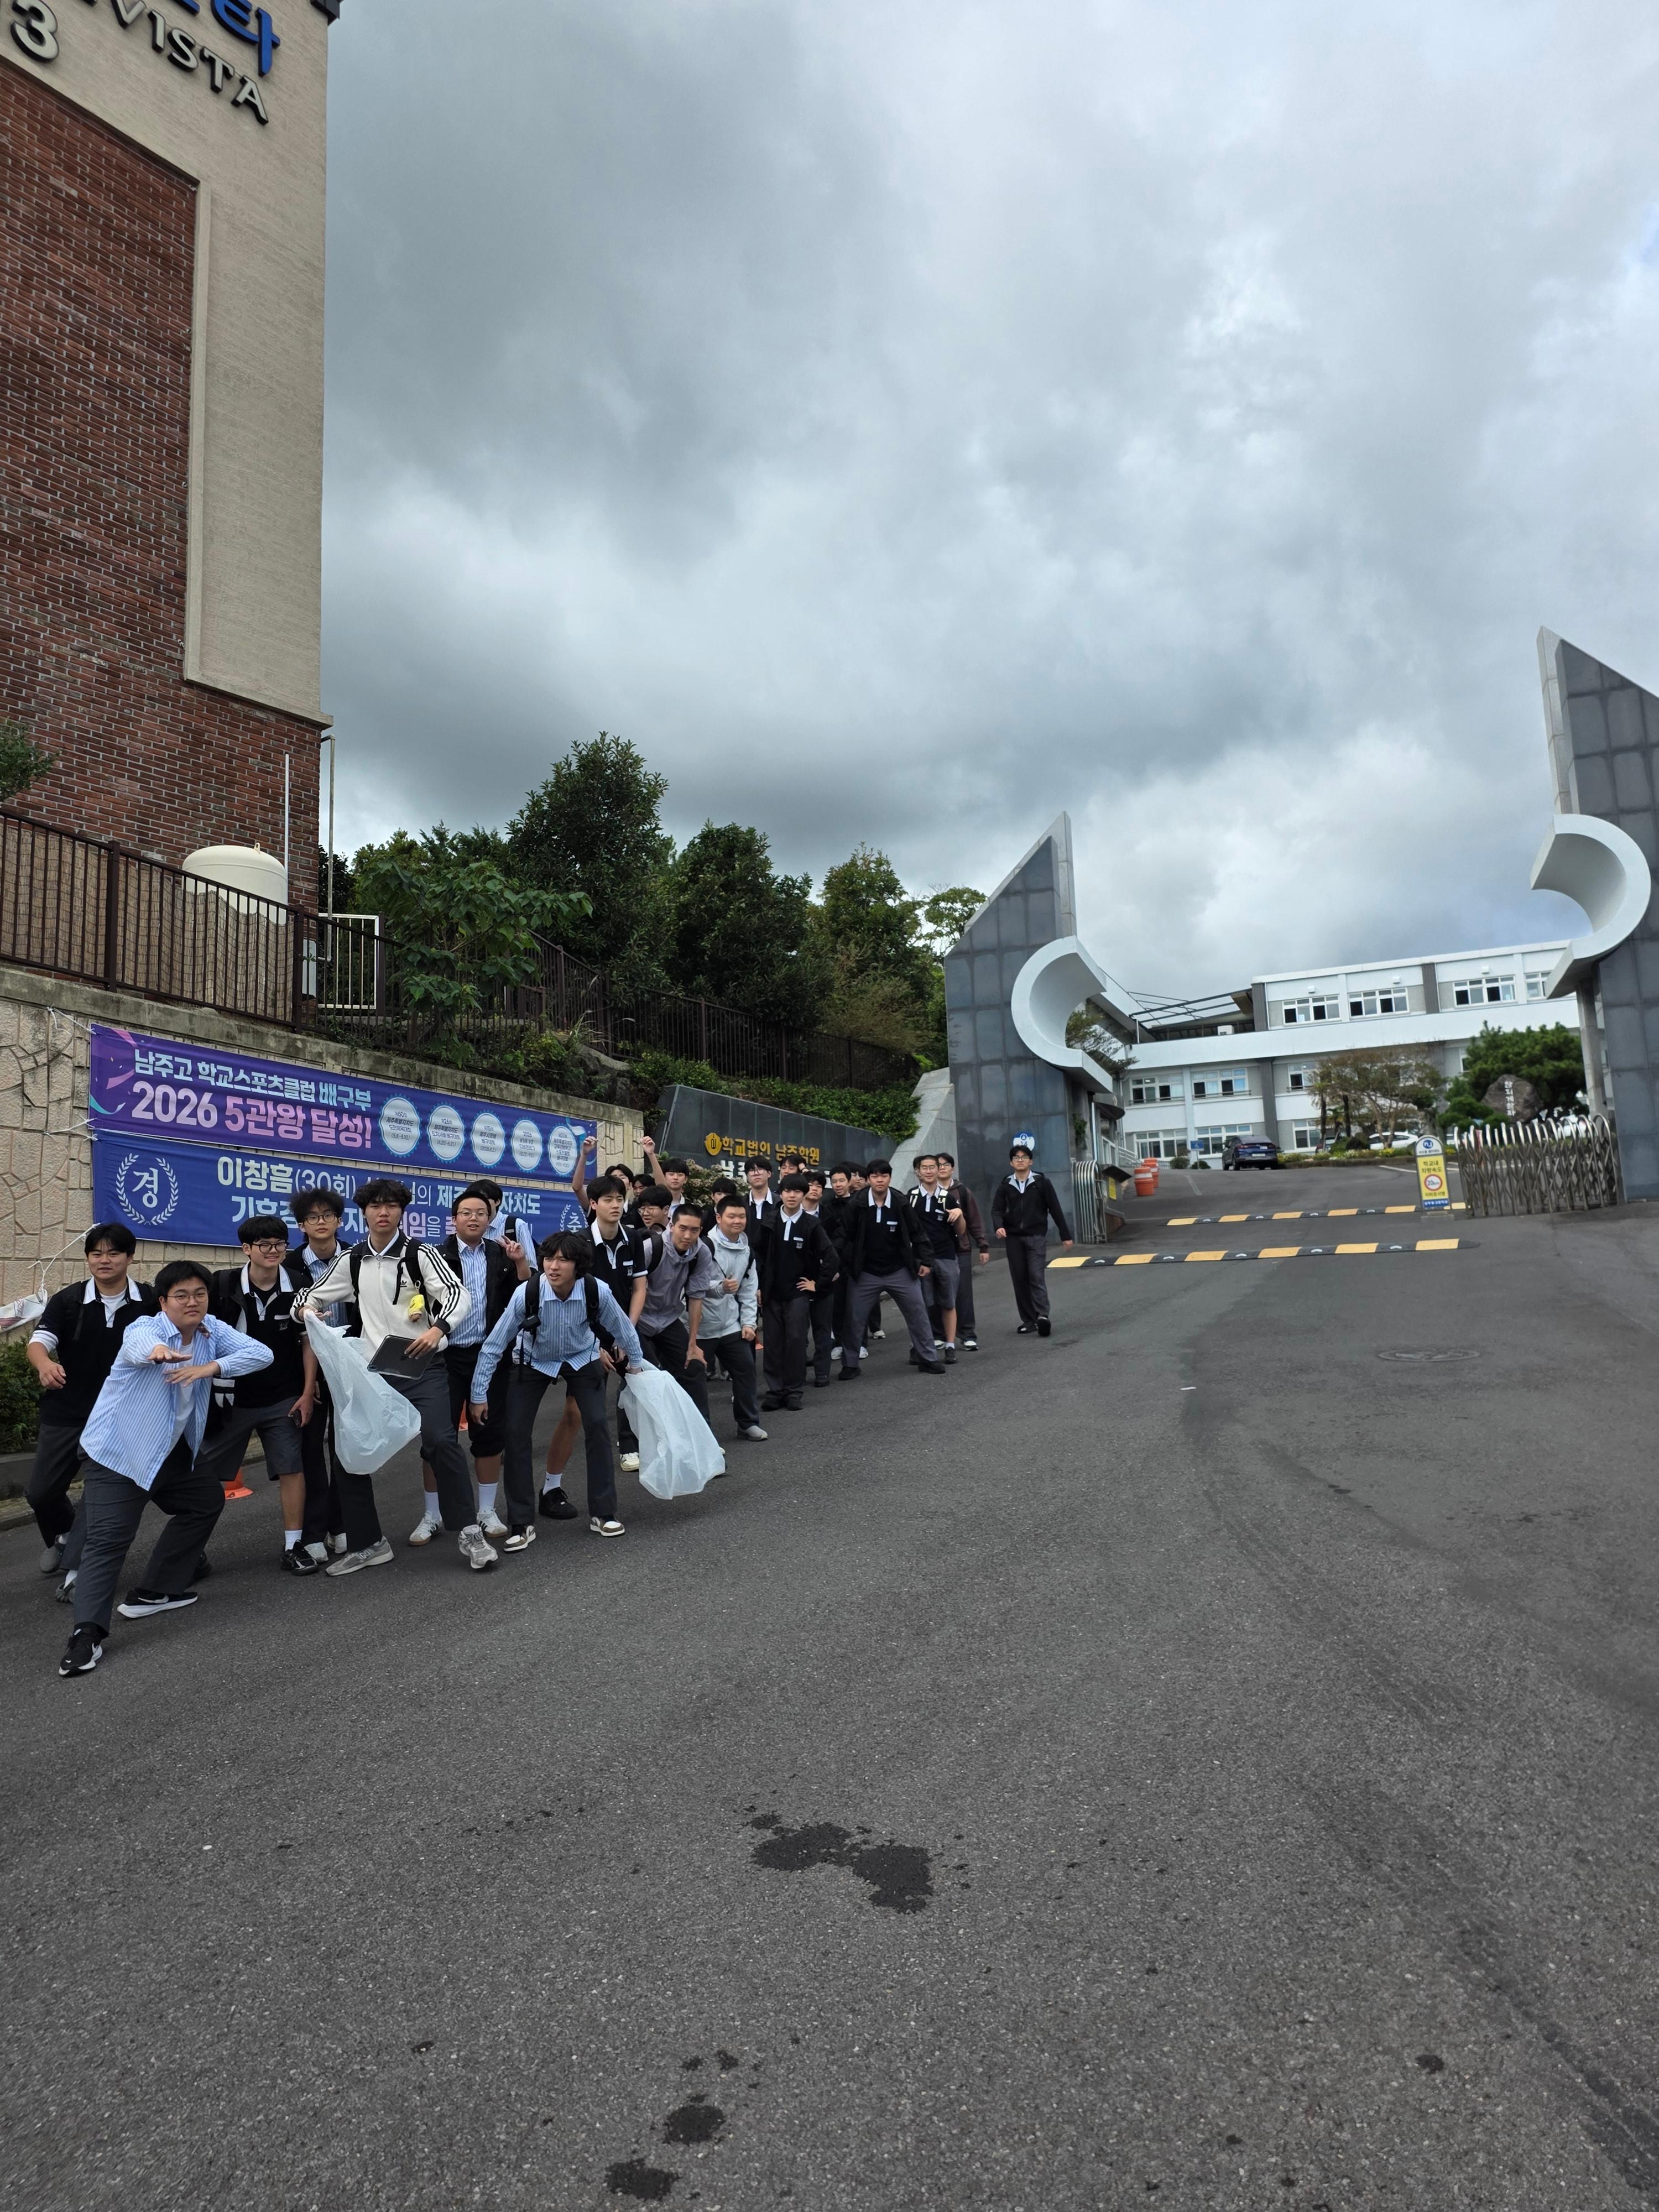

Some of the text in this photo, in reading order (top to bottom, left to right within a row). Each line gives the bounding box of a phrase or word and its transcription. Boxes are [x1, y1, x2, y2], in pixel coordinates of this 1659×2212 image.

[134, 1049, 371, 1111] 남주고 학교스포츠클럽 배구부
[132, 1081, 372, 1149] 2026 5관왕 달성!
[722, 1136, 770, 1160] 학교법인
[132, 1167, 158, 1208] 경
[217, 1156, 356, 1200] 이창흠(30회)
